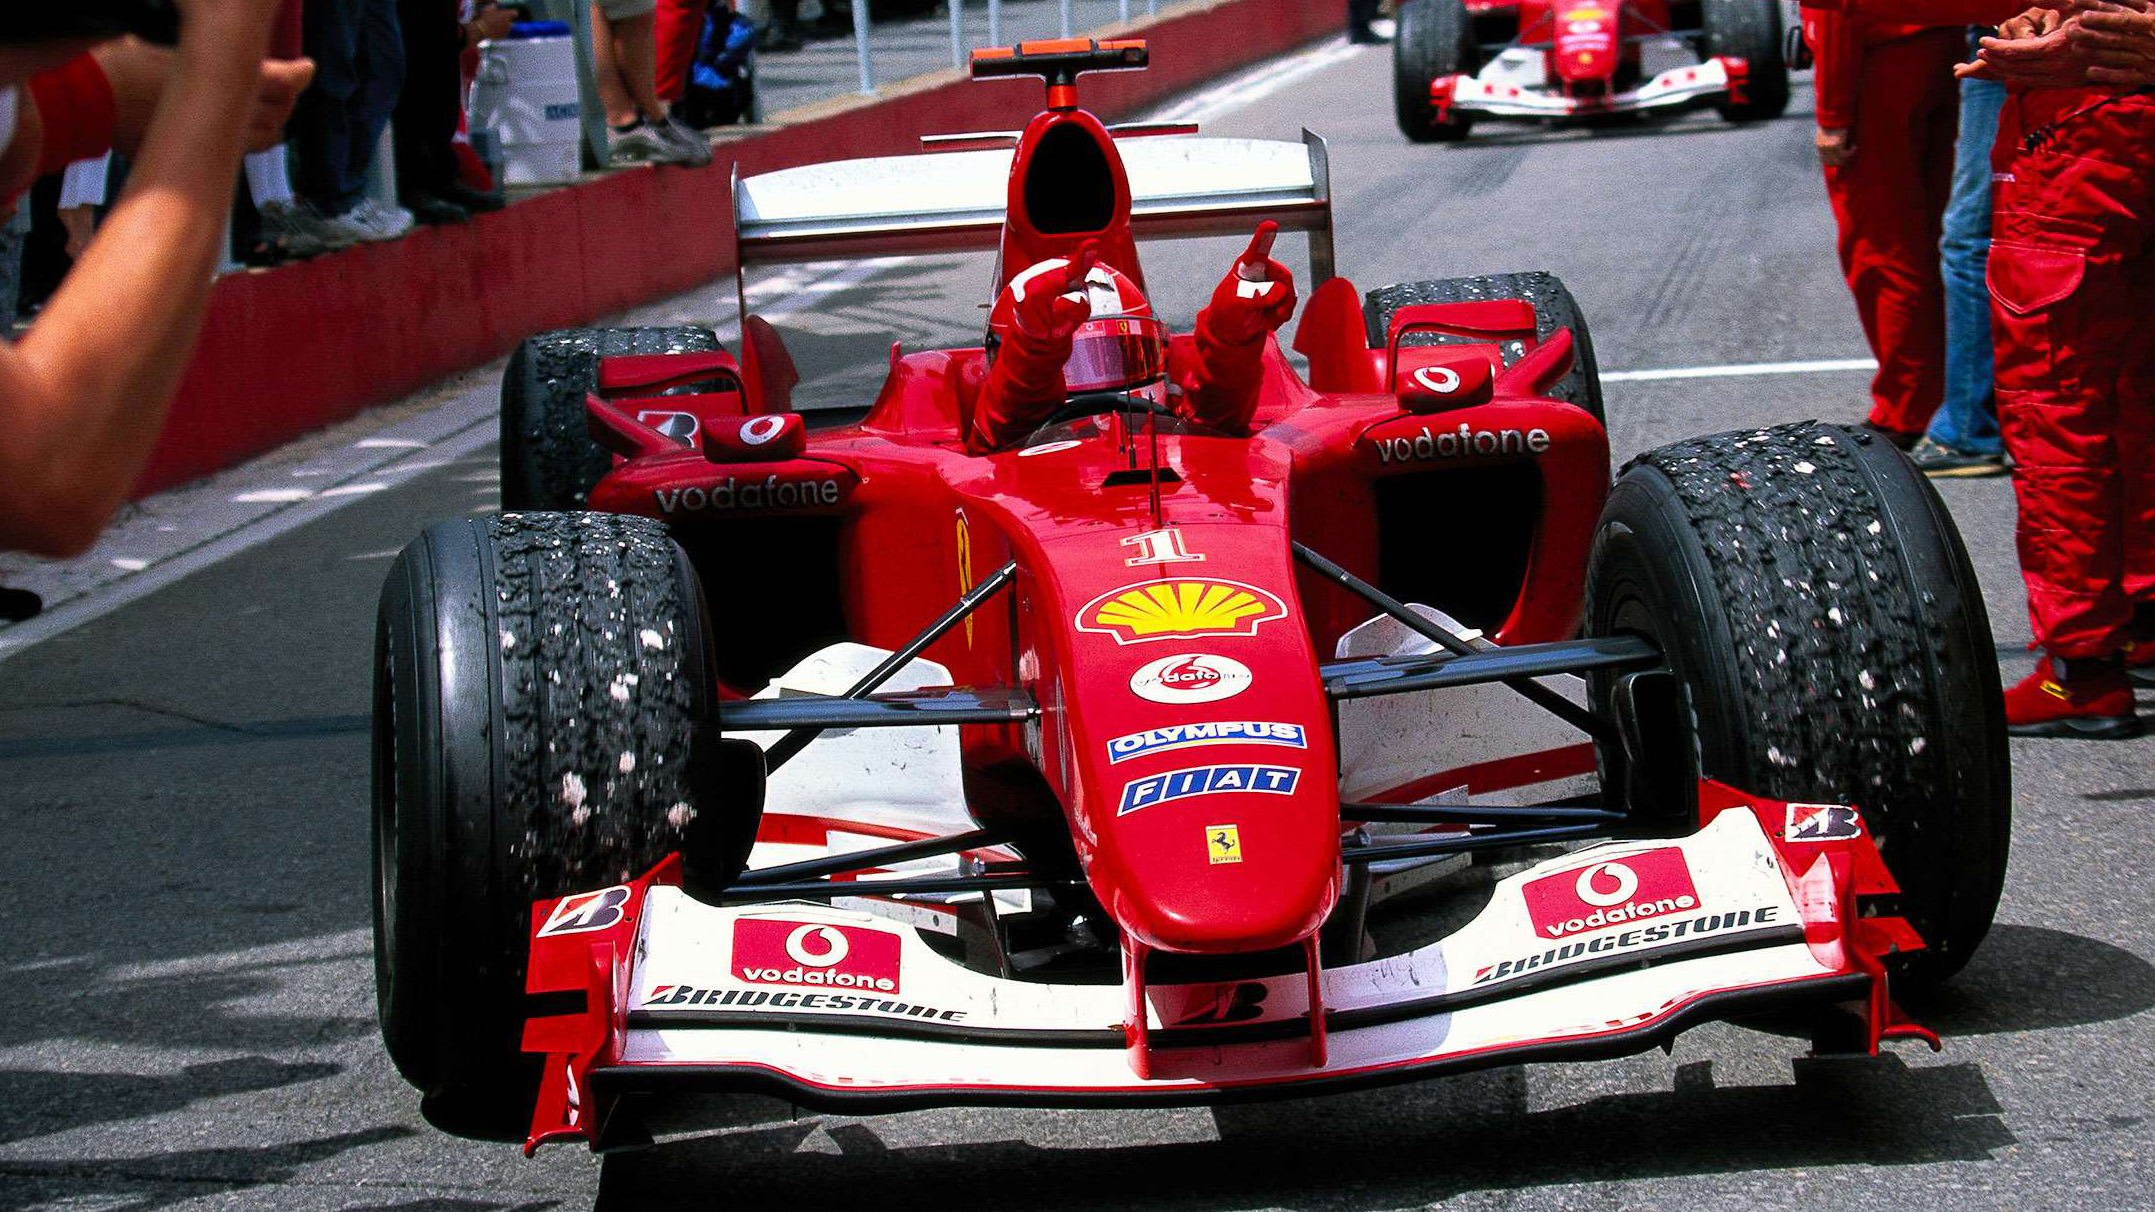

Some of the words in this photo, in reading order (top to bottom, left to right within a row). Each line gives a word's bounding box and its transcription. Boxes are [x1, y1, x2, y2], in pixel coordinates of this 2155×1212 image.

[1375, 423, 1550, 463] vodafone
[655, 474, 839, 514] vodafone
[1120, 528, 1206, 567] 1
[1133, 669, 1252, 688] vodafo
[1114, 722, 1299, 753] OLYMPUS
[1132, 770, 1289, 806] FIAT
[1546, 895, 1695, 937] vodafone
[1472, 906, 1778, 985] BRIDGESTONE
[742, 965, 895, 992] vodafone
[642, 985, 968, 1022] BRIDGESTONE
